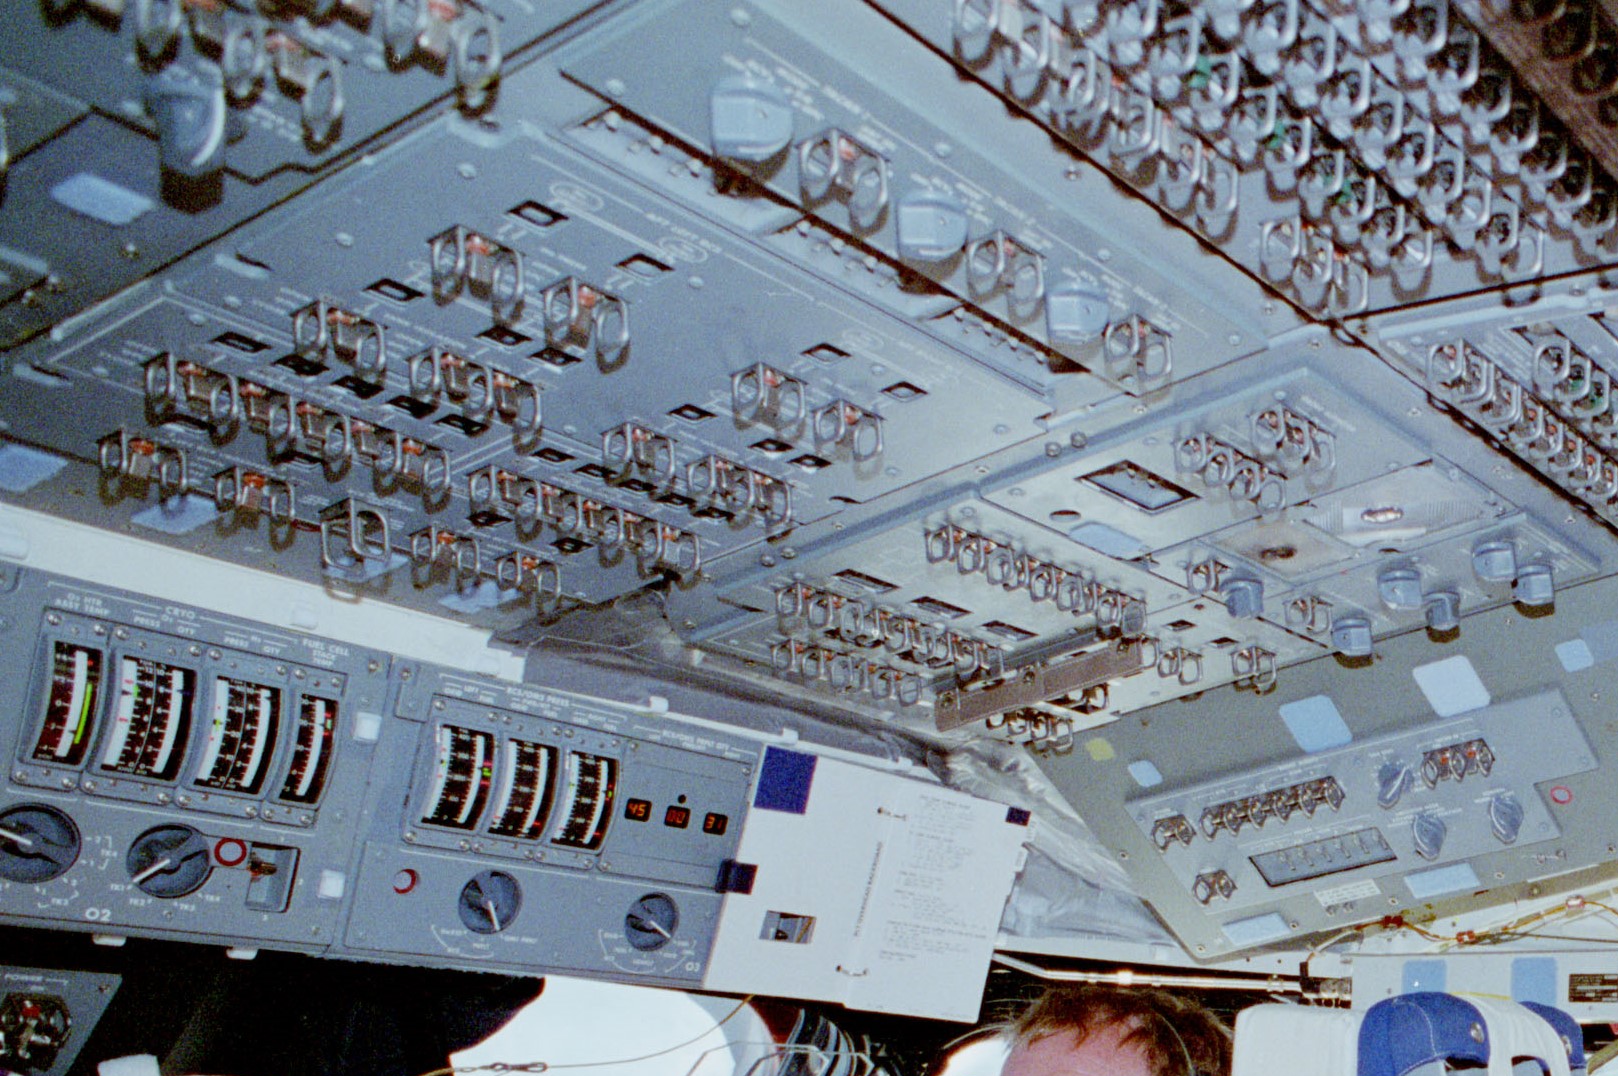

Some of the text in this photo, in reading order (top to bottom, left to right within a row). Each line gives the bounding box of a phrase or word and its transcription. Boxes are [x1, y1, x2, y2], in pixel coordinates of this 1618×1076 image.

[165, 605, 196, 620] CRYO
[302, 638, 325, 651] FUEL
[629, 802, 645, 818] 45
[706, 815, 722, 830] 31
[85, 907, 111, 922] O2
